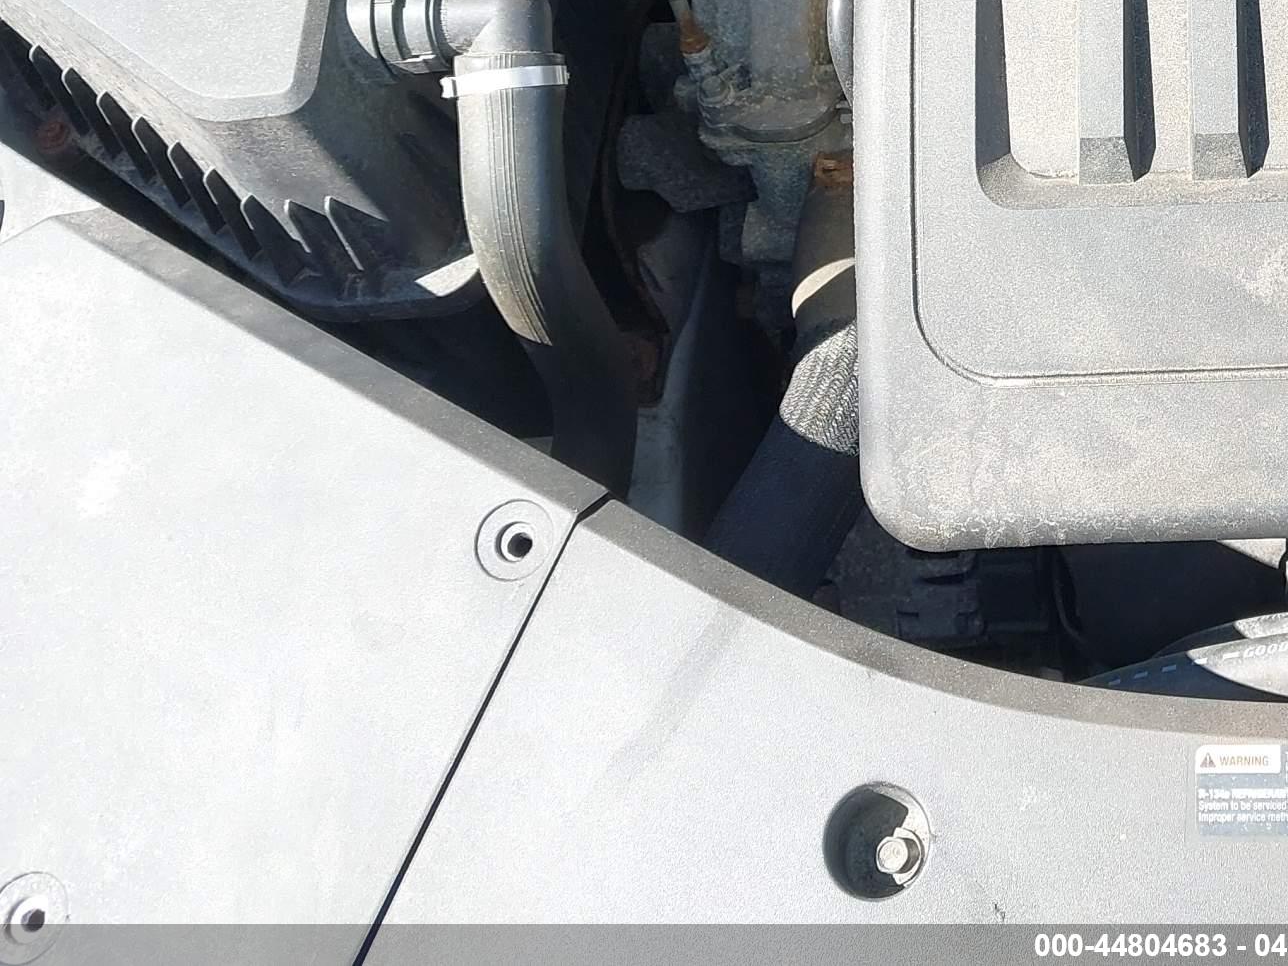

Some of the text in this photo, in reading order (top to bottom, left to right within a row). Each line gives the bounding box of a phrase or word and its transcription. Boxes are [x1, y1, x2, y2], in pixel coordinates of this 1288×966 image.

[1219, 755, 1269, 766] WARNING
[1199, 800, 1229, 812] System
[1231, 800, 1239, 810] to
[1241, 800, 1250, 810] be
[1253, 800, 1286, 810] serviced
[1199, 812, 1233, 825] Improper
[1237, 812, 1265, 822] service
